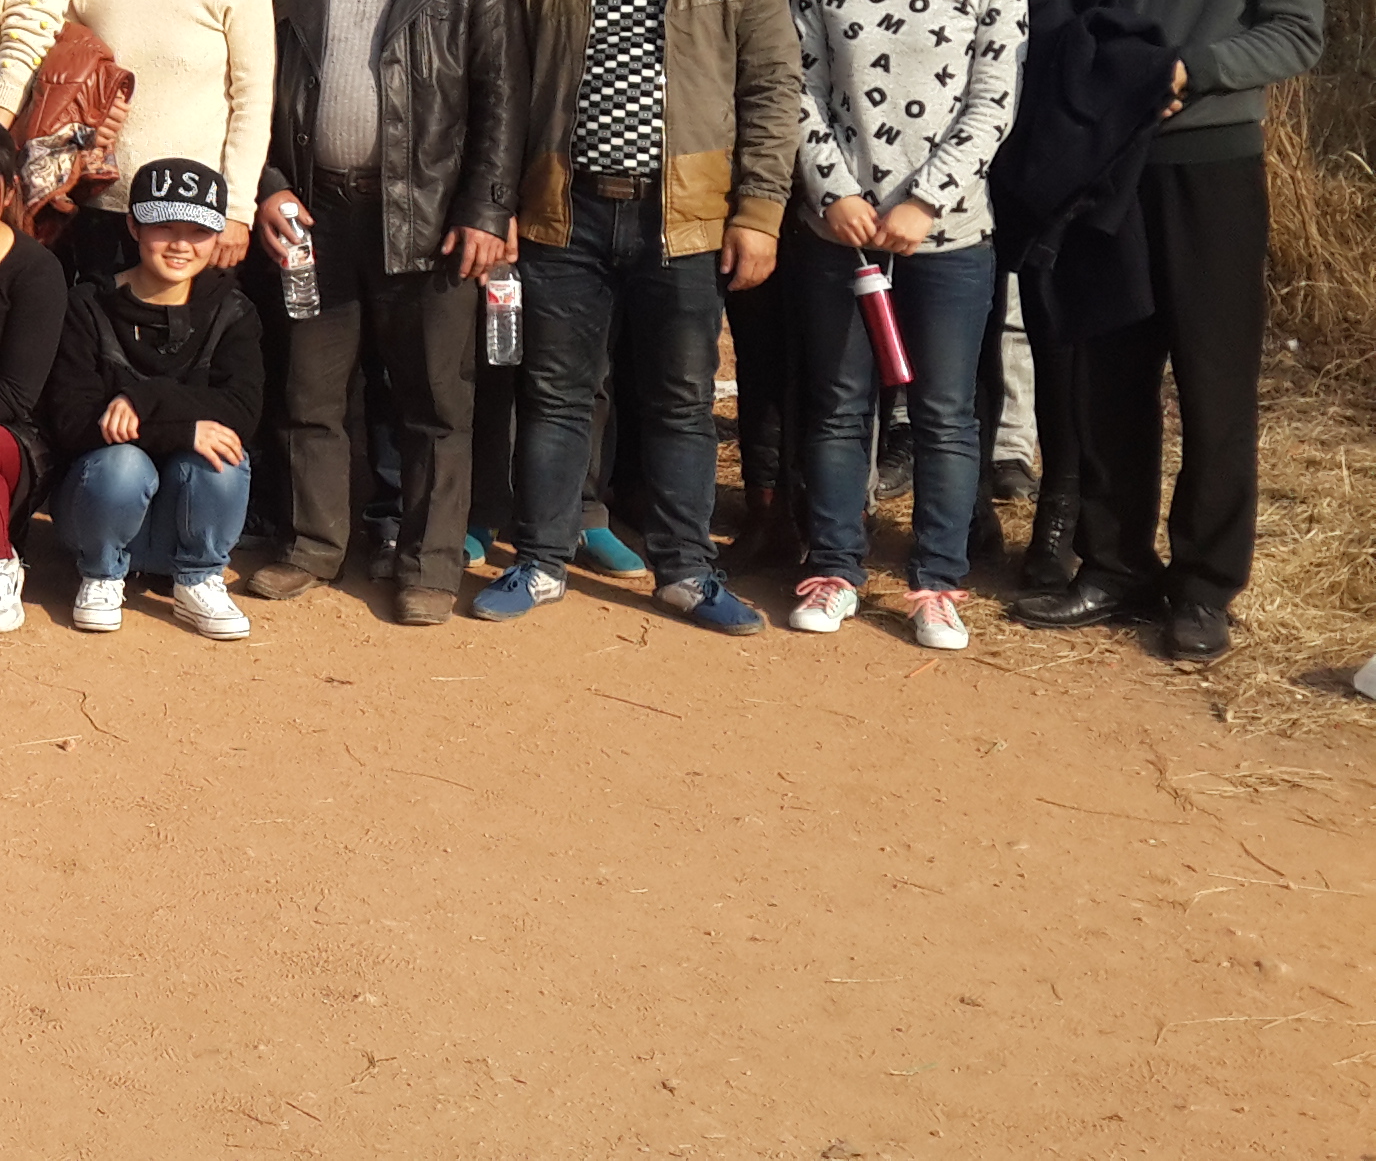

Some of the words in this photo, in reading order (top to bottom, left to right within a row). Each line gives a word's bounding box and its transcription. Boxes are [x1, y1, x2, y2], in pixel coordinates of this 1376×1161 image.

[877, 13, 906, 35] M
[981, 8, 1001, 26] S
[843, 22, 864, 40] S
[928, 25, 952, 47] X
[981, 40, 1006, 60] H
[870, 53, 890, 73] A
[934, 63, 956, 88] K
[865, 87, 887, 108] D
[905, 100, 925, 118] O
[151, 168, 219, 208] USA
